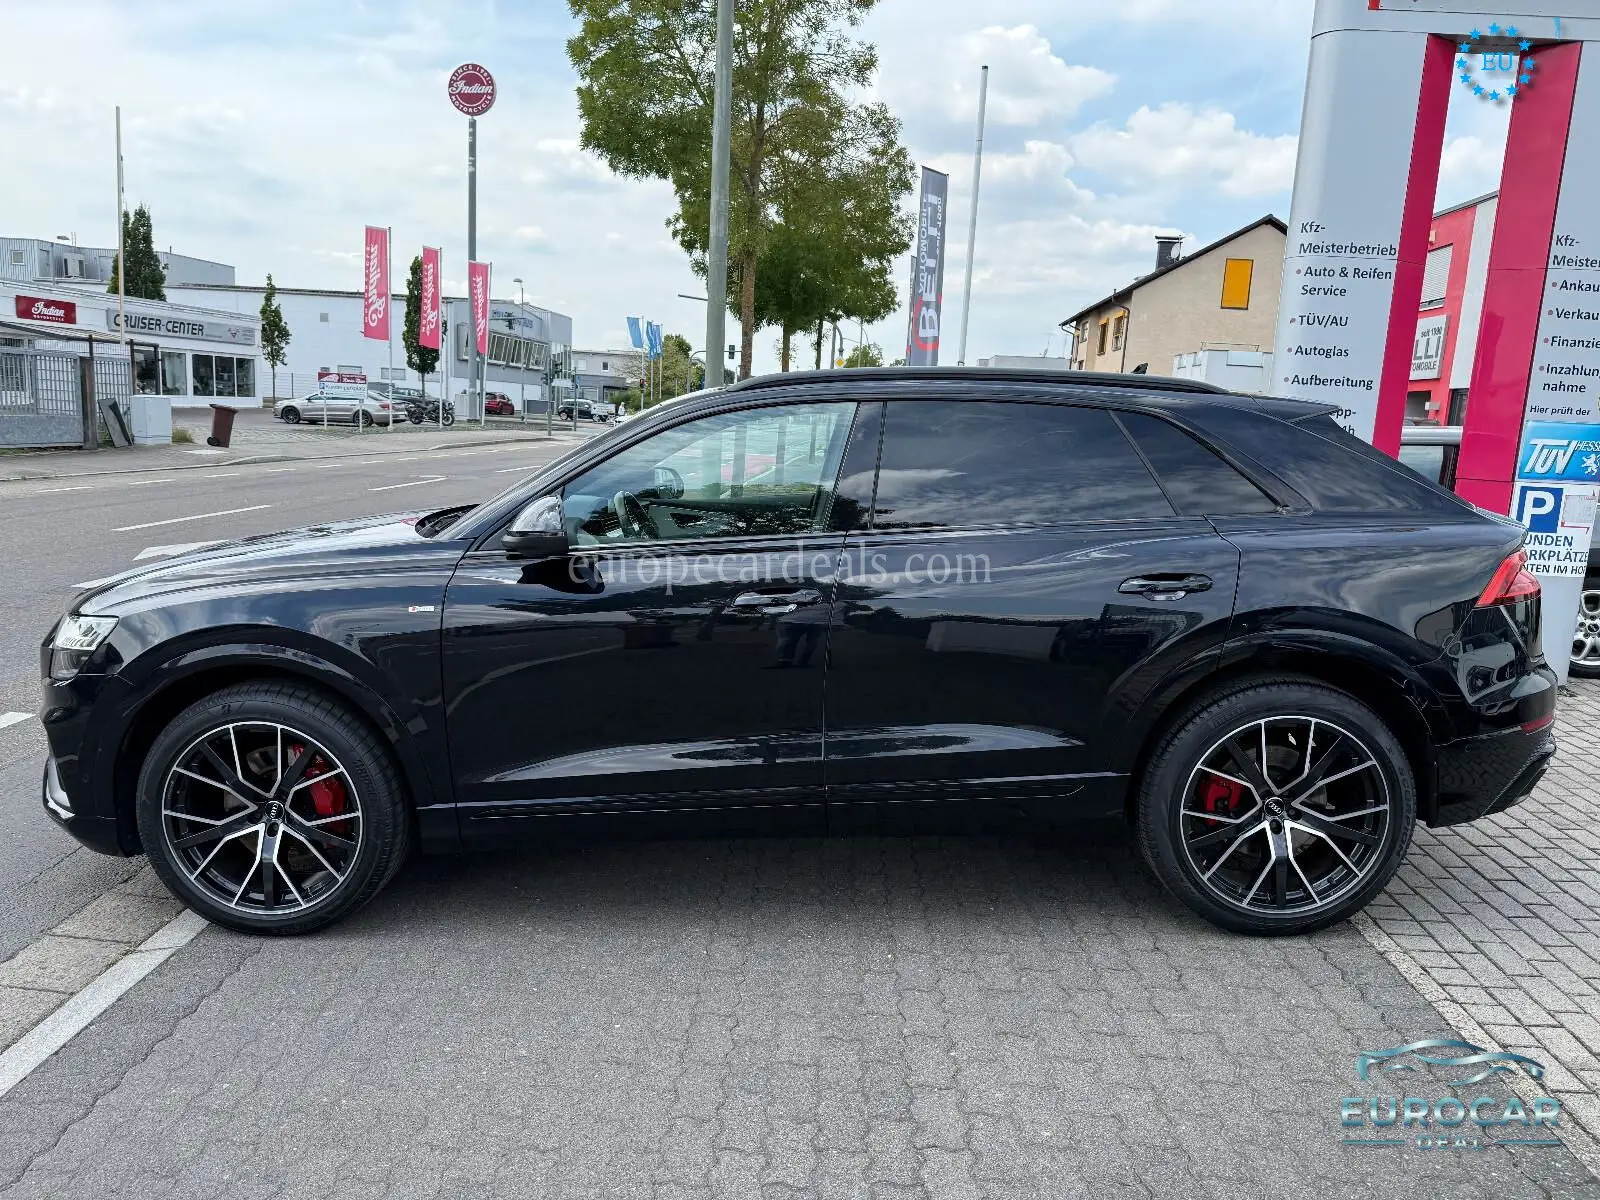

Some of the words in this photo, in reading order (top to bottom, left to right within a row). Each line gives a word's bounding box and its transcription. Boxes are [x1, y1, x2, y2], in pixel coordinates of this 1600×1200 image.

[451, 65, 473, 81] SINCE
[448, 80, 494, 94] Indian
[451, 95, 492, 113] MOTORCYCLE
[1300, 221, 1326, 234] Kfz-
[1556, 234, 1581, 247] Kfz-
[1299, 242, 1397, 256] Meisterbetrieb
[1304, 266, 1336, 278] Auto
[1339, 267, 1349, 278] &
[1353, 267, 1392, 280] Reifen
[1301, 285, 1347, 297] Service
[1559, 280, 1600, 292] Ankau
[31, 301, 65, 317] Indian
[1556, 307, 1600, 321] Verkau
[113, 313, 205, 337] CRUISER-CENTER
[1298, 313, 1348, 328] TÜV/AU
[1294, 344, 1350, 359] Autoglas
[1546, 363, 1600, 379] Inzahlun
[1291, 374, 1374, 391] Aufbereitung
[1543, 381, 1586, 393] nahme
[1530, 404, 1549, 414] Hier
[1550, 406, 1573, 416] prüft
[1575, 407, 1592, 416] der
[1523, 490, 1555, 531] P
[1553, 564, 1568, 574] IM
